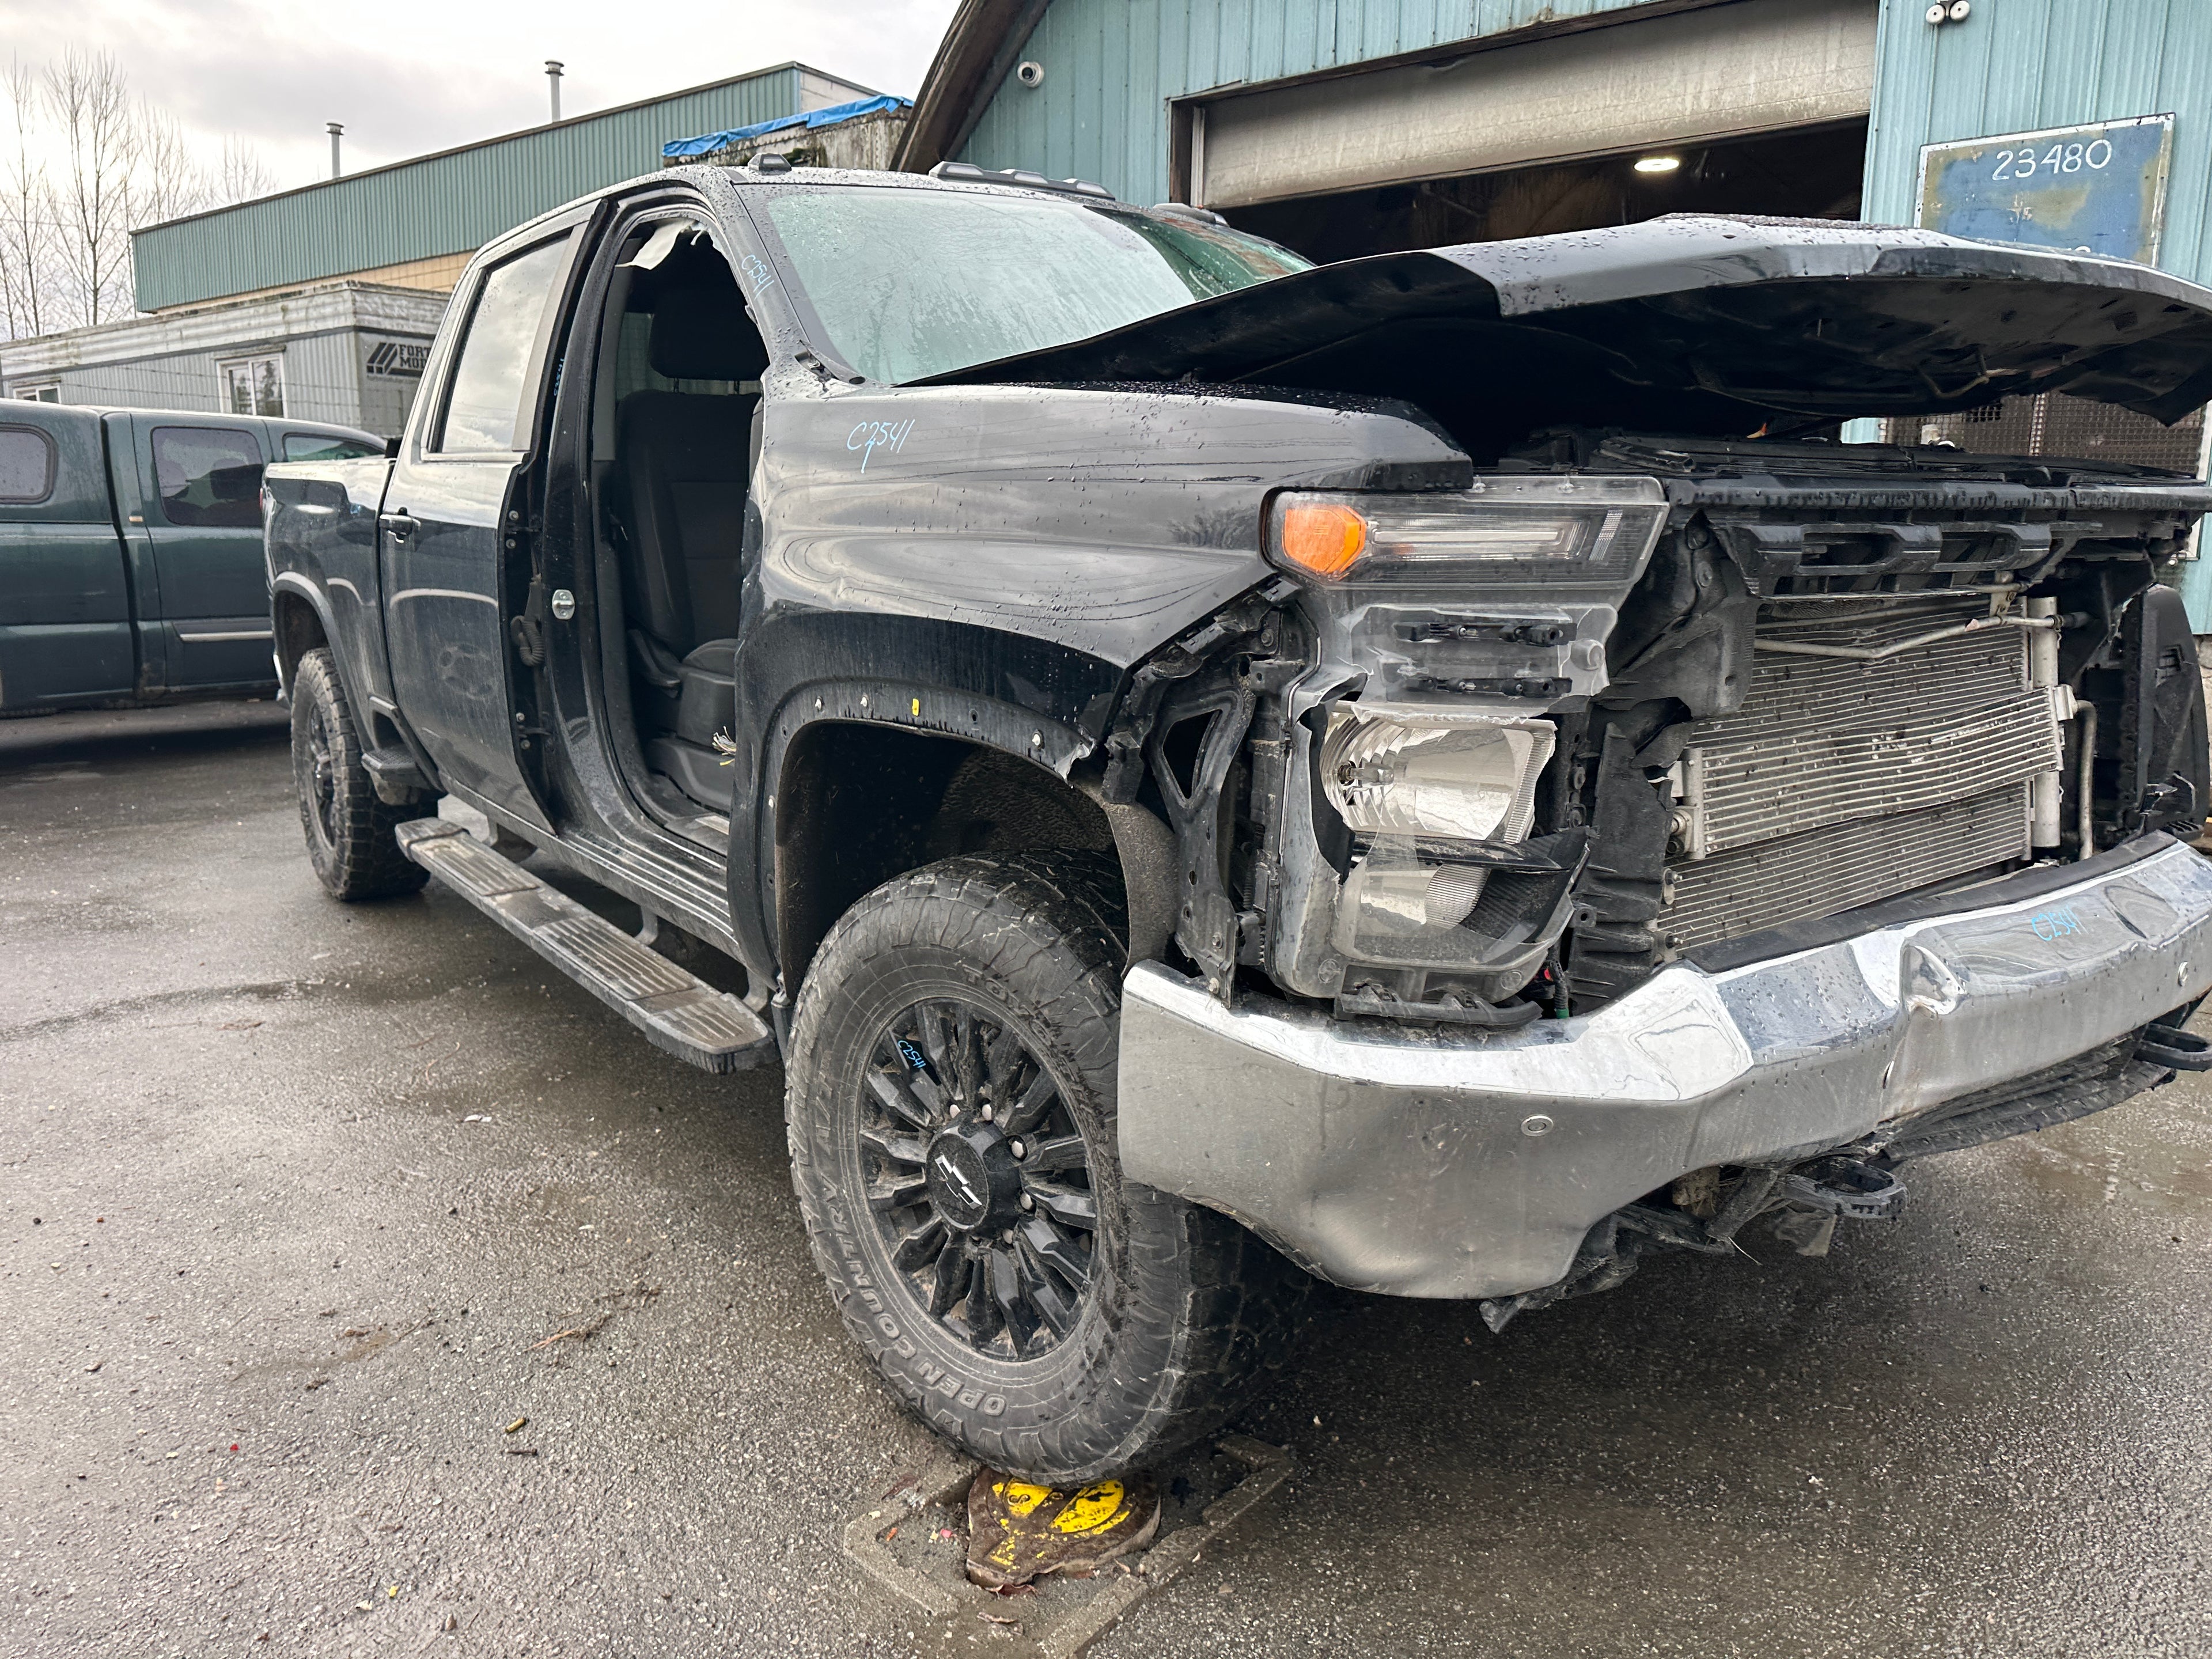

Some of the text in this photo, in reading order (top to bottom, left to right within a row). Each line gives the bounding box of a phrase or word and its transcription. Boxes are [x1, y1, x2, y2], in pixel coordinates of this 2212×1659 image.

[1992, 139, 2112, 181] 23480
[741, 254, 775, 301] C2541
[398, 343, 431, 358] FORT
[846, 419, 916, 469] C2541
[2031, 904, 2090, 941] C2541
[897, 1040, 927, 1069] C2541
[914, 1356, 1007, 1416] OPEN
